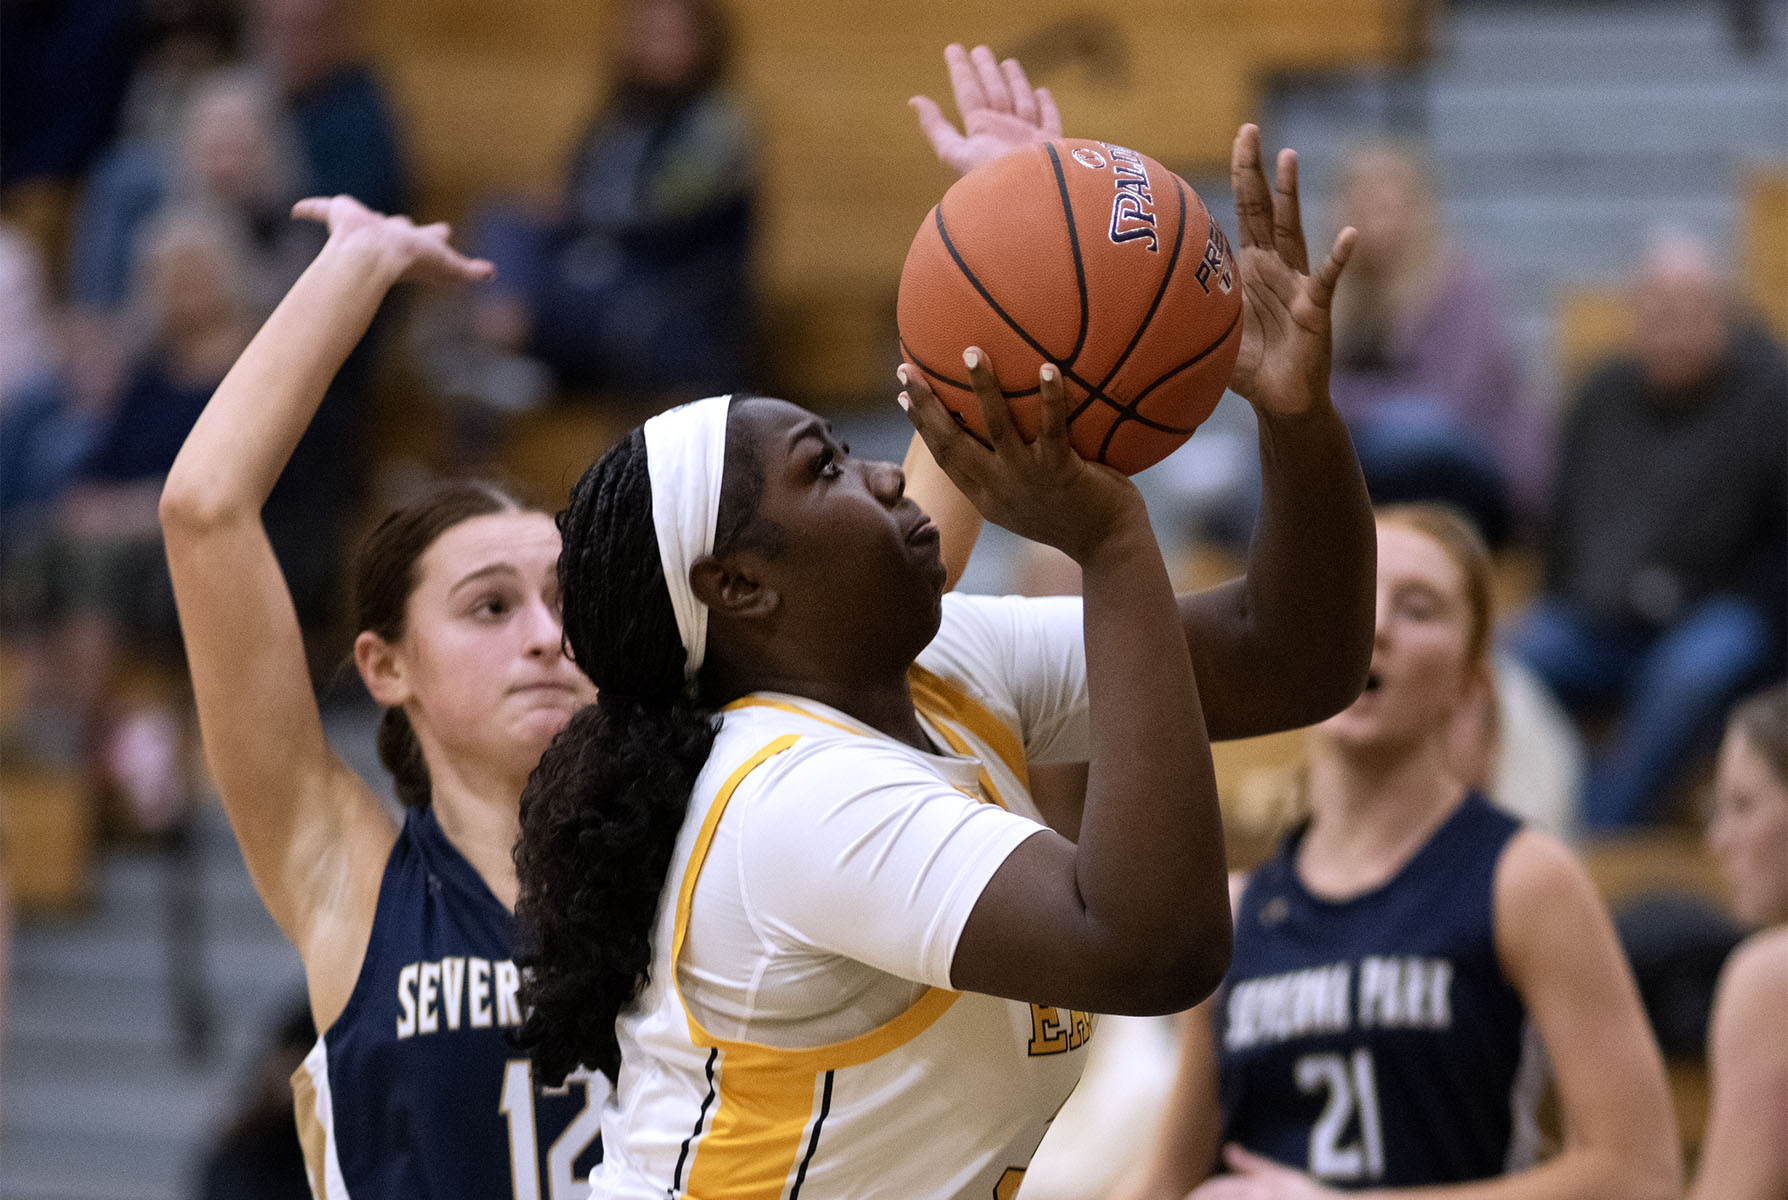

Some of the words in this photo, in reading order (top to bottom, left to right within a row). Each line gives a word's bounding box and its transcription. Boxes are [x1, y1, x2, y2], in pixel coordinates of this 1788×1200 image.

[1104, 144, 1159, 254] SPALD
[396, 956, 524, 1040] SEVER
[1028, 1002, 1094, 1057] EA
[1358, 956, 1451, 1031] PARK
[1296, 1050, 1383, 1179] 21
